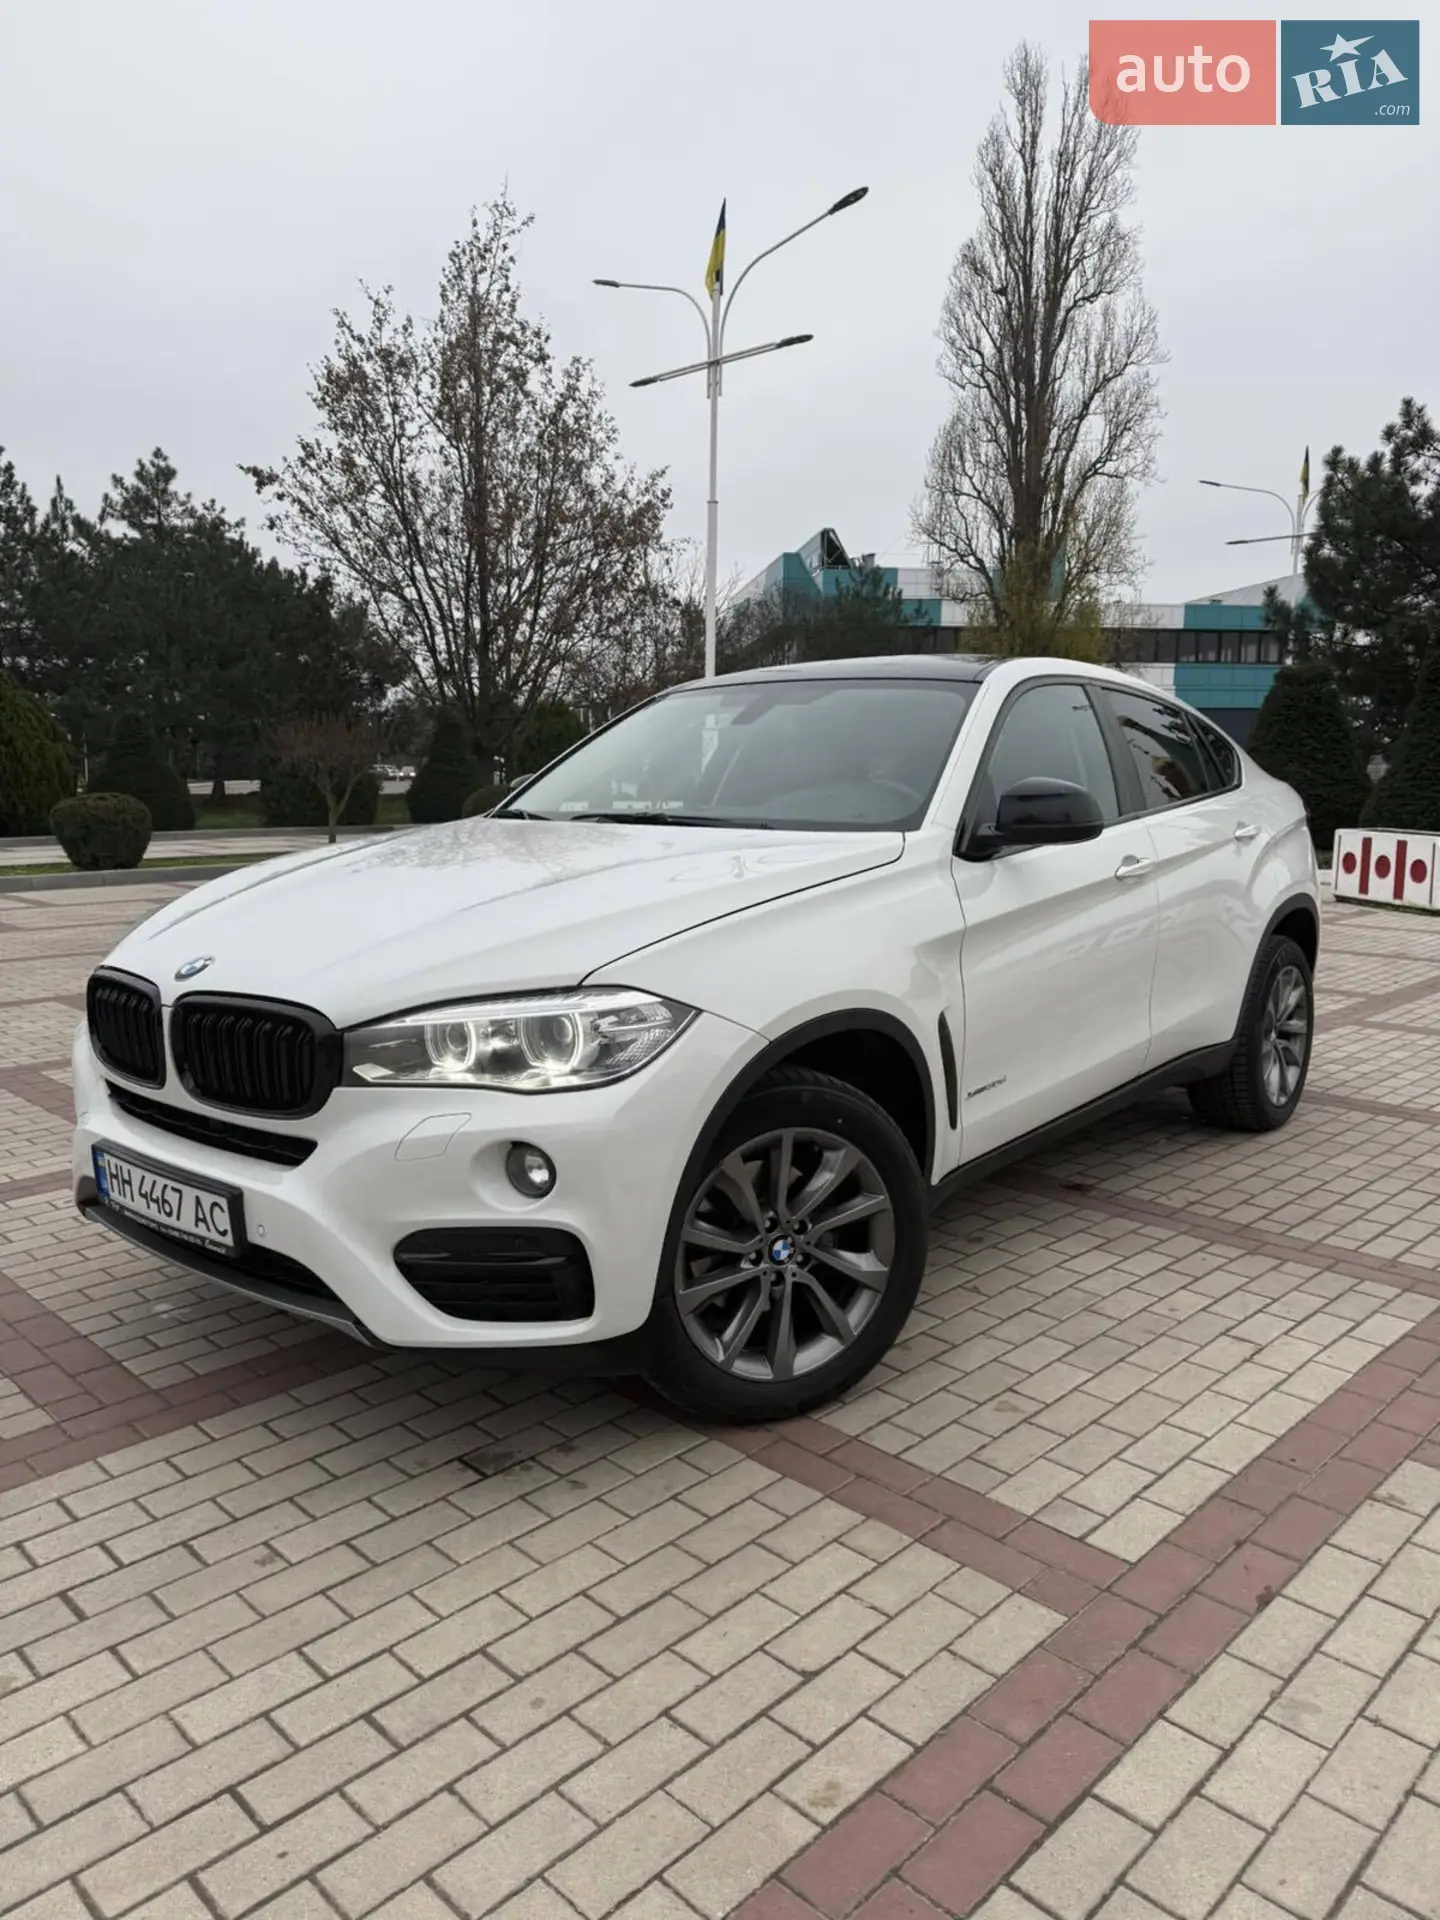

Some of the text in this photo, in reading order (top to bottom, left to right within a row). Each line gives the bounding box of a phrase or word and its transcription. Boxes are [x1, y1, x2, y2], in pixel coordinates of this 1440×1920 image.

[107, 1159, 135, 1202] HH
[138, 1175, 183, 1222] 4467
[194, 1195, 229, 1238] AC
